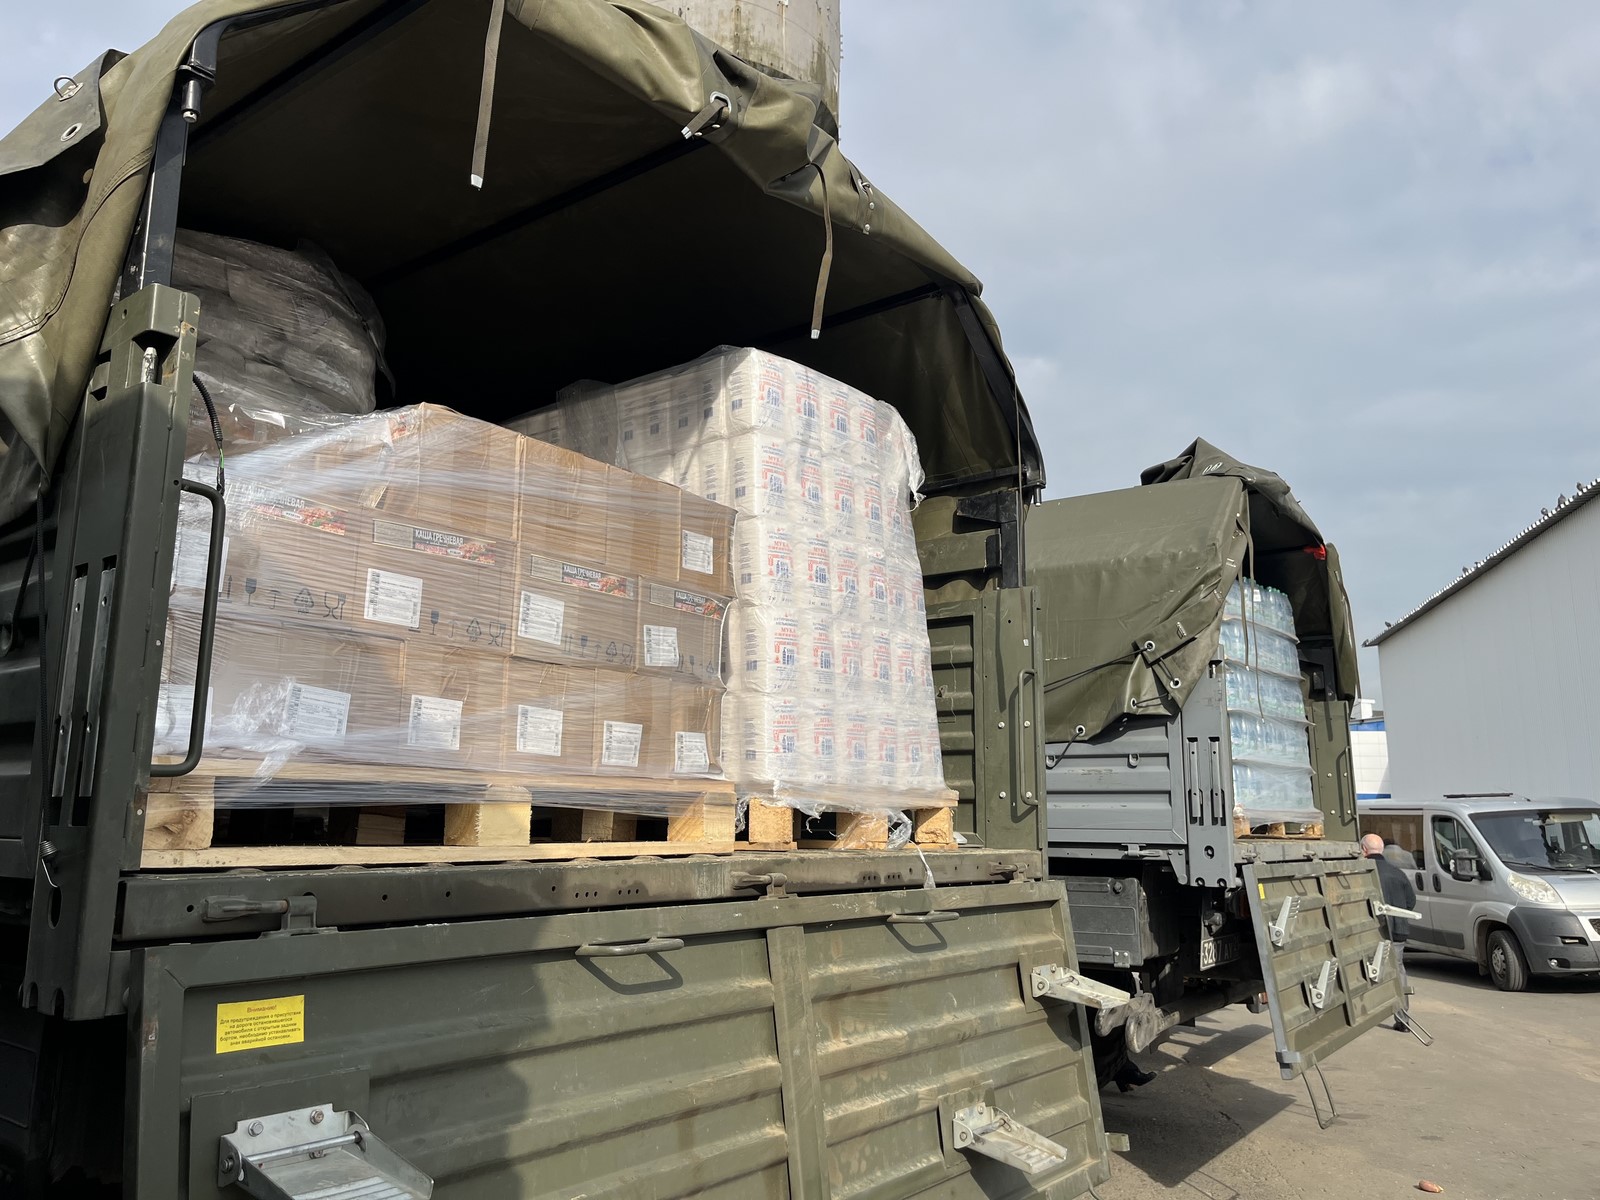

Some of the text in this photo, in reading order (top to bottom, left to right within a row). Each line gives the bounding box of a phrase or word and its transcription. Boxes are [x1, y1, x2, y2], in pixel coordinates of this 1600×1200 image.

[415, 529, 434, 541] КАША
[432, 533, 465, 546] ГРЕЧНЕВАЯ
[563, 565, 578, 575] КАША
[577, 568, 601, 580] ГРЕЧНЕВАЯ
[230, 1014, 269, 1023] предупреждения
[224, 1027, 253, 1036] автомобиля
